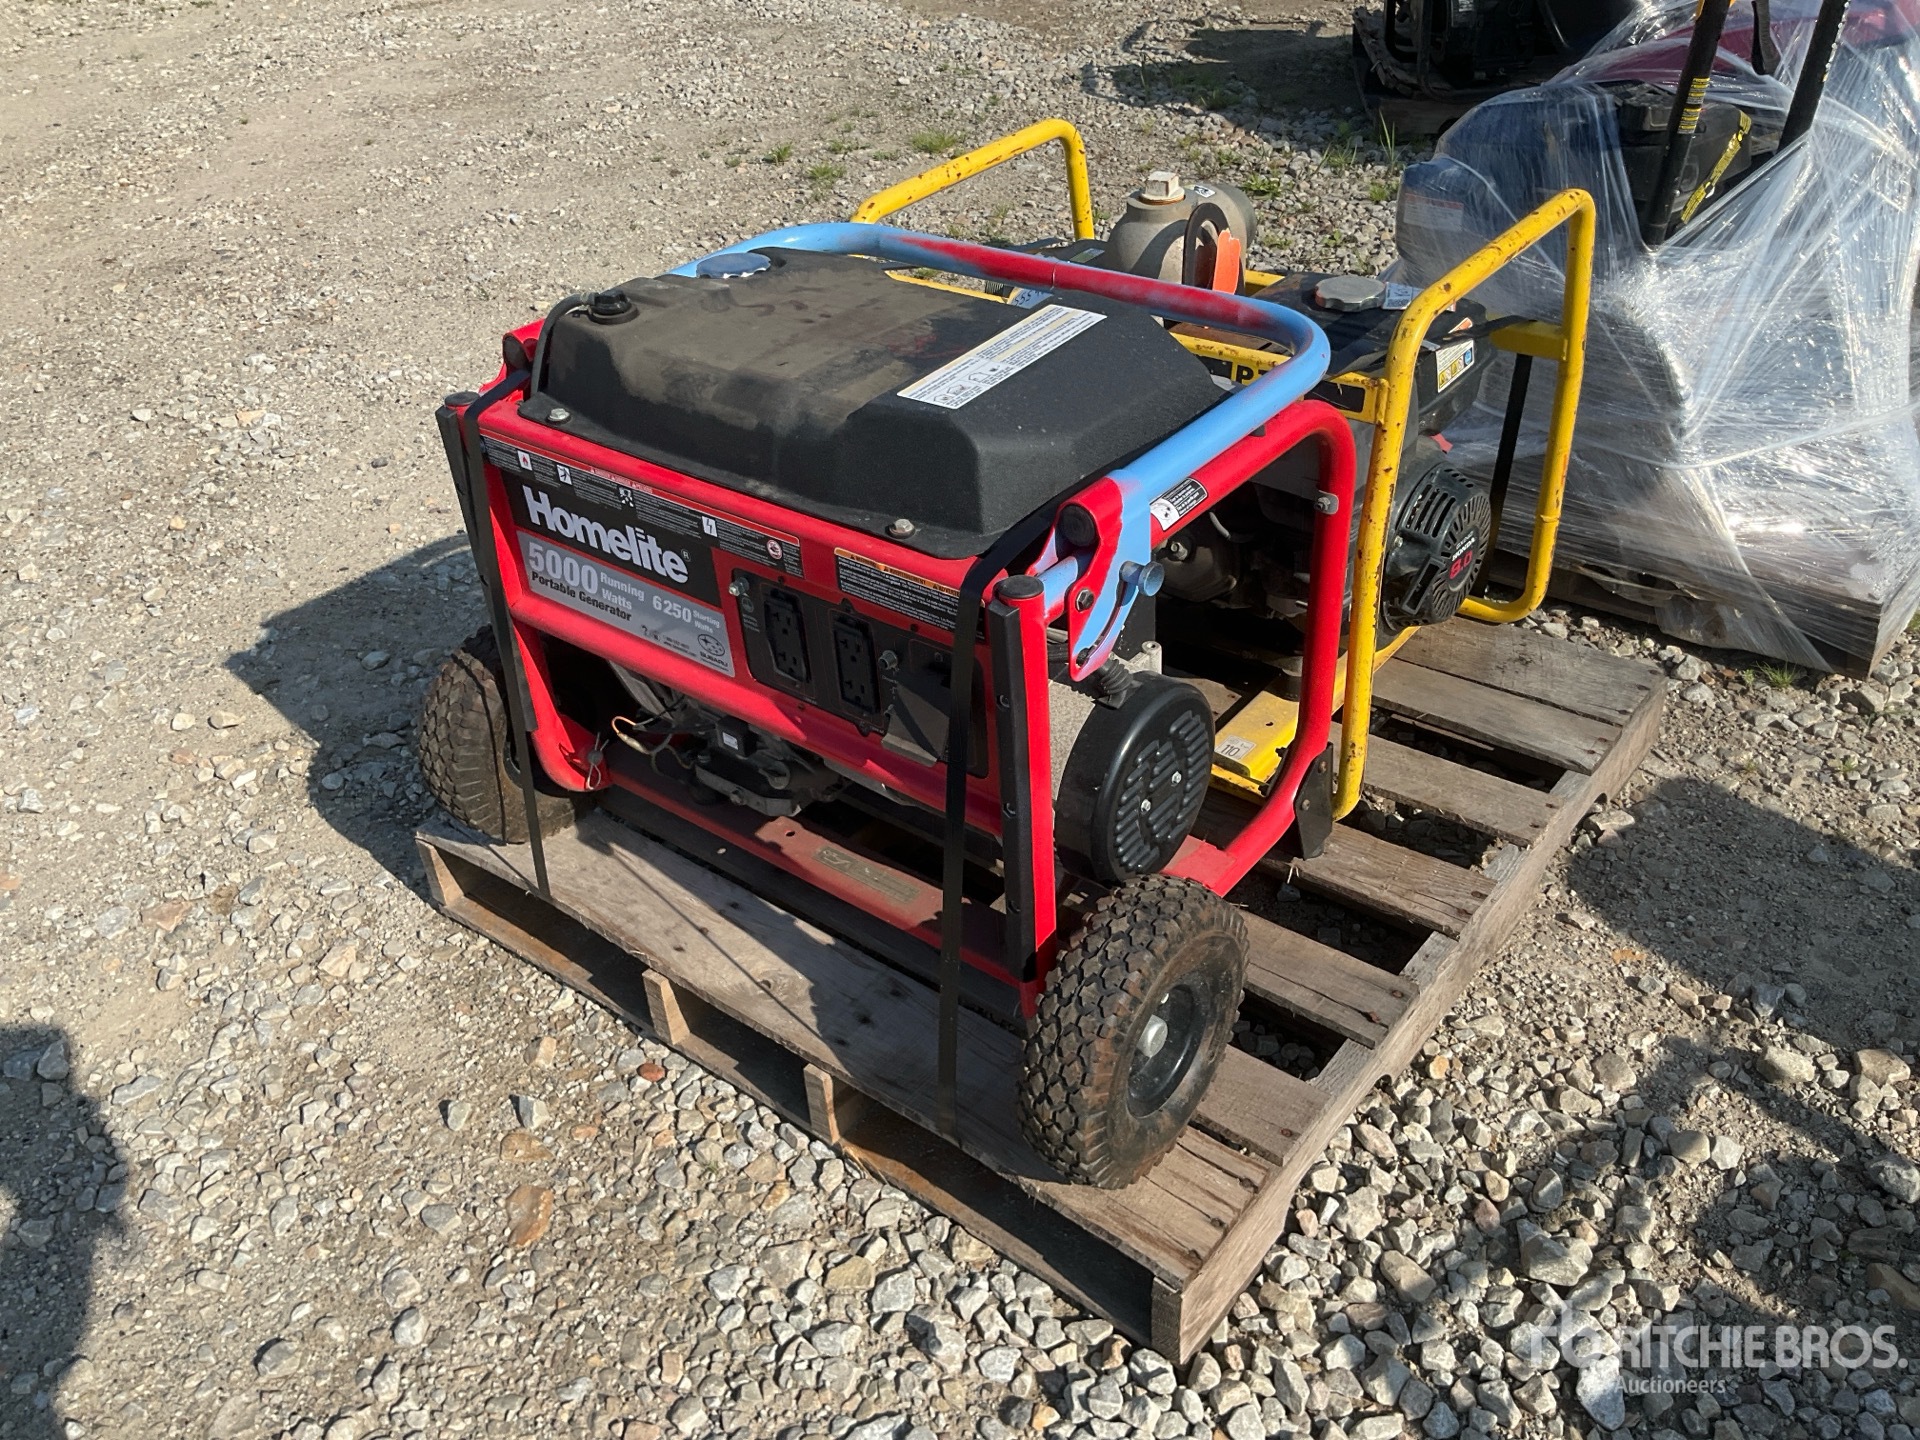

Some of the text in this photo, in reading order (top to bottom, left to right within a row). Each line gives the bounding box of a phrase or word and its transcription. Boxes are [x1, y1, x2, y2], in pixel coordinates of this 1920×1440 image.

[522, 484, 689, 584] Homelite
[1452, 537, 1476, 562] HONDA
[527, 541, 599, 595] 5000
[1449, 550, 1473, 580] 8.0
[531, 571, 632, 622] Portable Generator
[600, 571, 645, 602] Running
[601, 588, 632, 611] Watts
[652, 595, 692, 623] 6250
[692, 609, 720, 629] Starting
[694, 620, 714, 634] Watts
